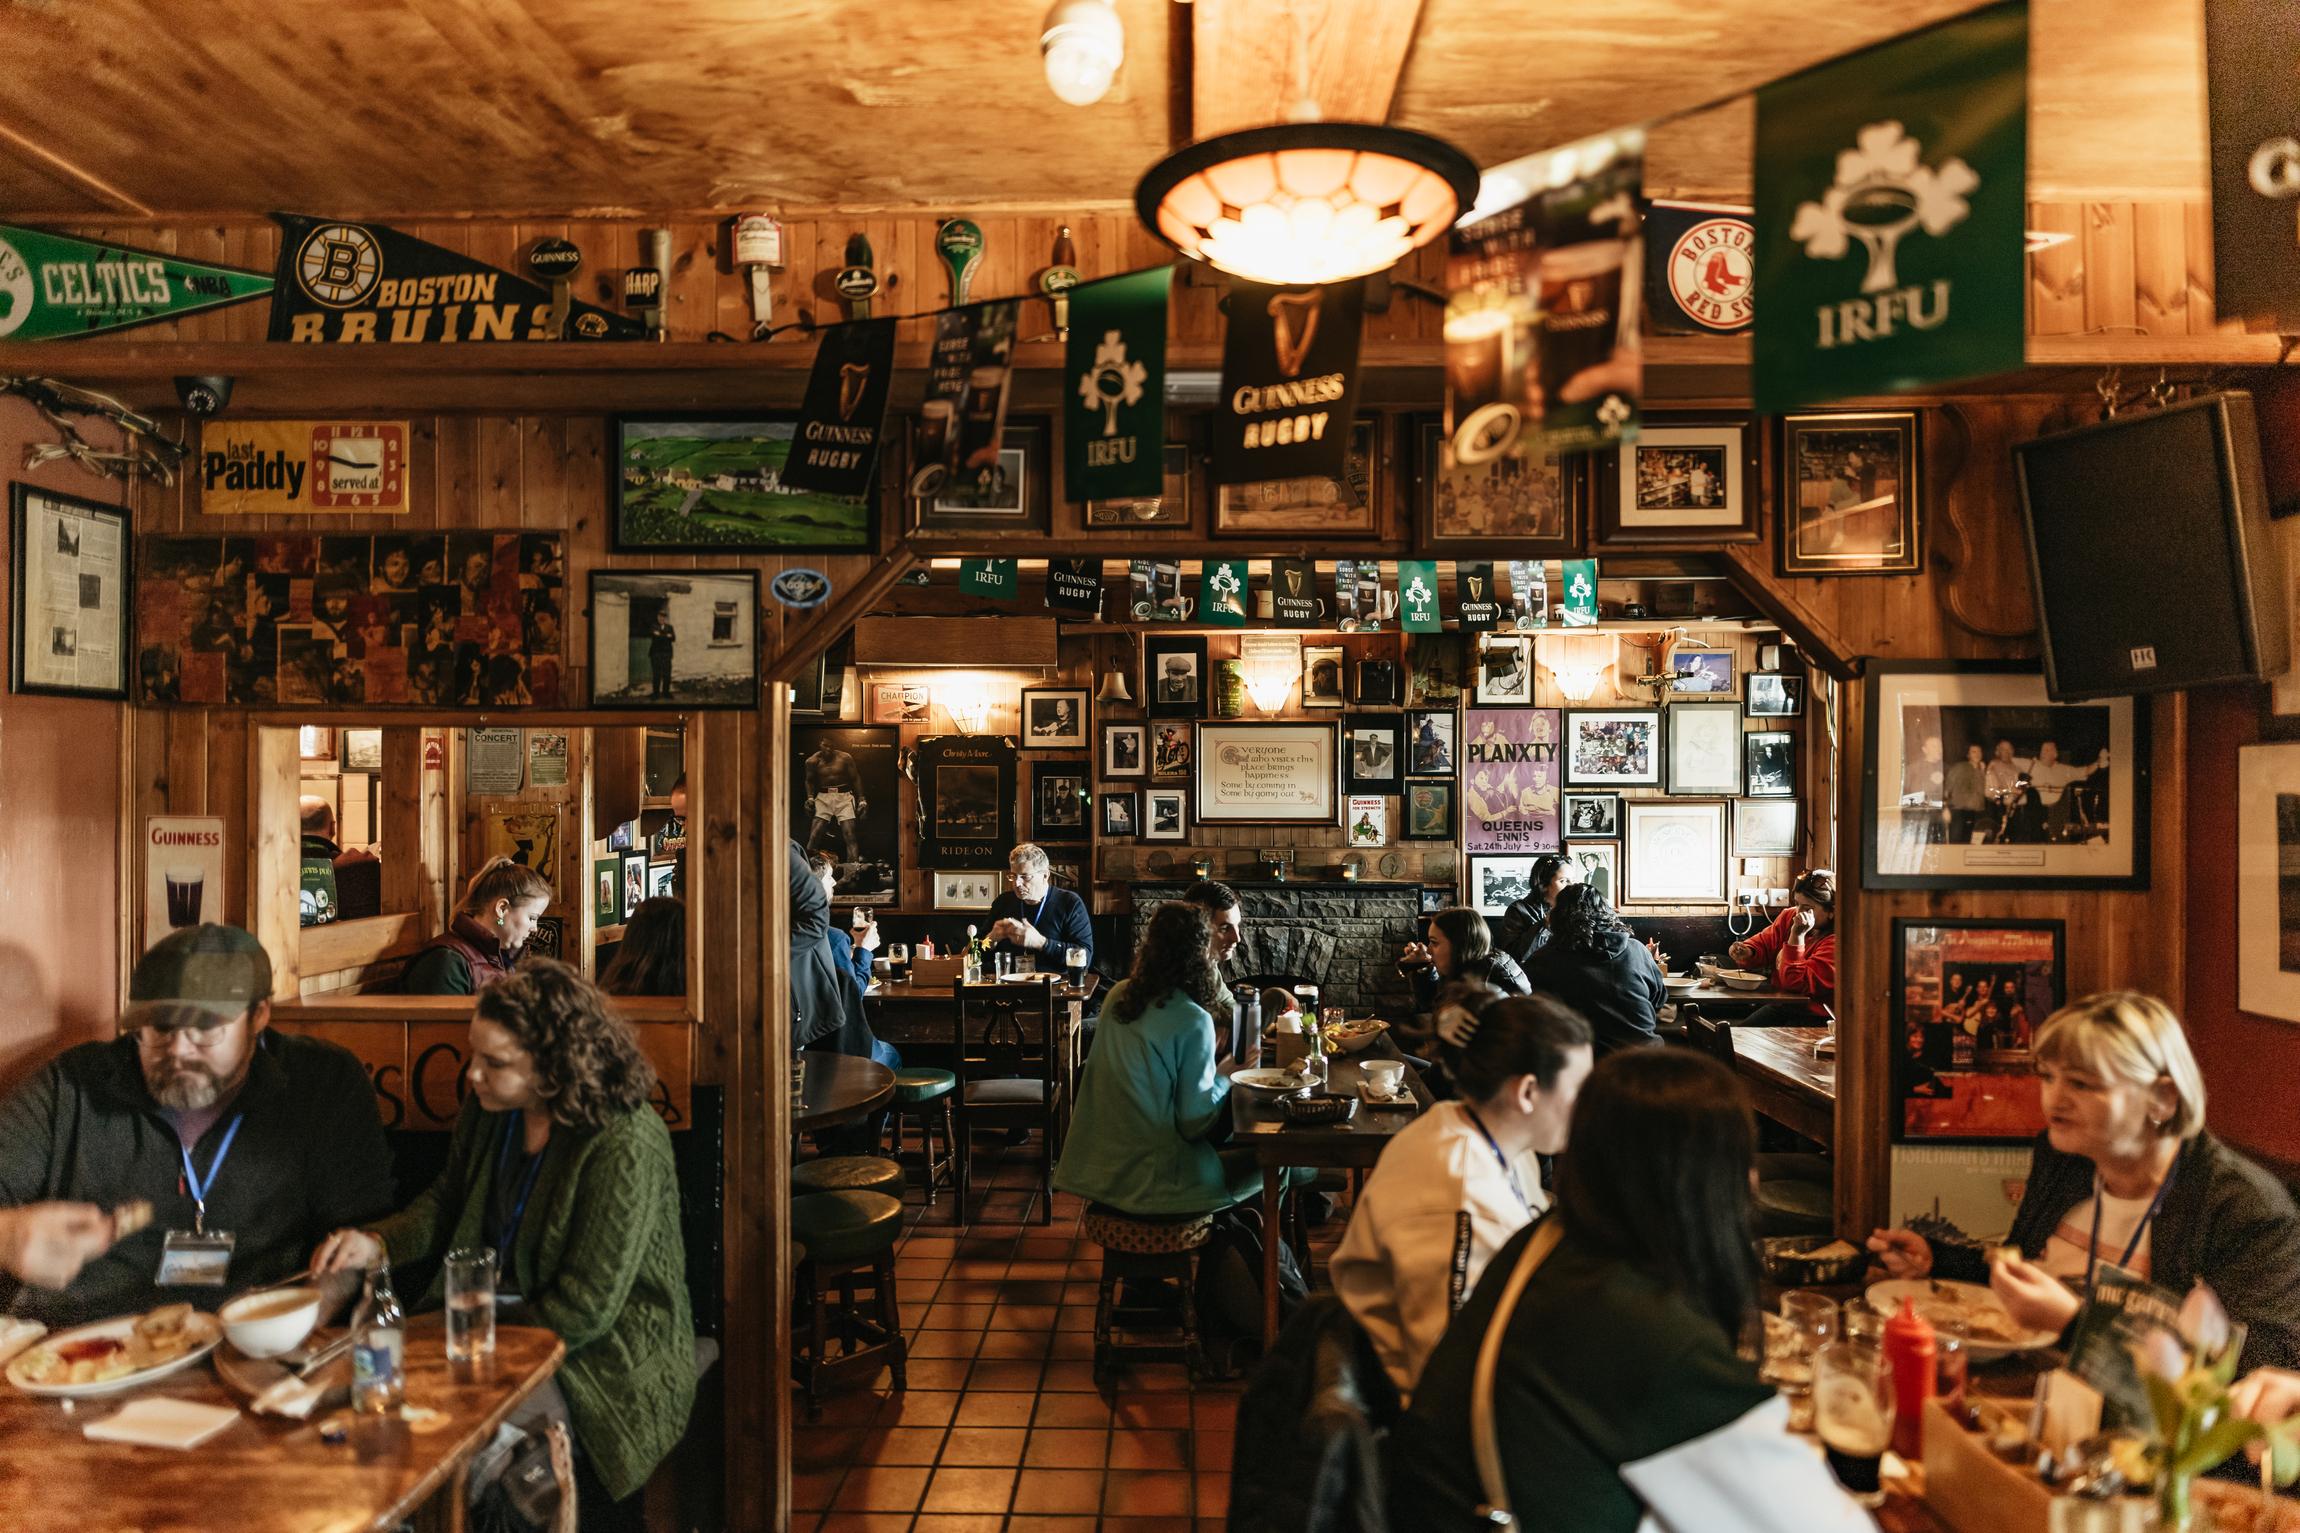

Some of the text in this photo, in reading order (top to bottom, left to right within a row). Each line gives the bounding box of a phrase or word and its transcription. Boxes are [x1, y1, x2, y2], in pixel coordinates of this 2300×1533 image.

[531, 251, 579, 264] GUINNESS
[319, 242, 359, 288] B
[41, 261, 171, 304] CELTICS
[192, 276, 232, 296] NBA
[625, 272, 659, 297] HARP
[377, 273, 498, 308] BOSTON
[1686, 291, 1721, 320] RED
[1817, 280, 1952, 349] IRFU
[1232, 372, 1346, 415] GUINNESS
[351, 427, 364, 437] 12
[805, 420, 874, 445] GUINNESS
[1243, 411, 1330, 450] RUGBY
[227, 438, 256, 461] last
[313, 440, 329, 451] 10
[388, 440, 398, 451] 2
[1087, 436, 1137, 467] IRFU
[807, 448, 863, 470] RUGBY
[316, 460, 325, 472] 9
[388, 460, 397, 472] 3
[206, 451, 306, 500] Paddy
[316, 481, 326, 492] 8
[332, 475, 379, 489] served at
[387, 481, 397, 492] 4
[331, 495, 338, 506] 7
[351, 495, 361, 506] 6
[372, 495, 380, 506] 5
[975, 571, 1003, 585] IRFU
[1053, 571, 1097, 587] GUINNESS
[1059, 586, 1092, 599] RUGBY
[1277, 596, 1313, 608] GUINNESS
[1461, 602, 1493, 612] GUINNESS
[1283, 609, 1310, 619] RUGBY
[1411, 613, 1430, 622] IRFU
[1467, 613, 1490, 622] RUGBY
[474, 734, 518, 743] CONCERT
[1467, 743, 1557, 762] PLANXTY
[1251, 755, 1314, 763] who visits this
[1240, 764, 1294, 772] place brings
[1245, 771, 1289, 779] happiness
[1245, 780, 1255, 789] by
[1256, 781, 1286, 790] coming
[1221, 789, 1241, 797] Some
[1244, 789, 1255, 798] by
[1255, 790, 1278, 799] going
[1482, 821, 1544, 832] QUEENS
[151, 827, 220, 846] GUINNESS
[1496, 832, 1530, 842] ENNIS
[1467, 843, 1483, 851] Sat.
[1503, 843, 1521, 851] July
